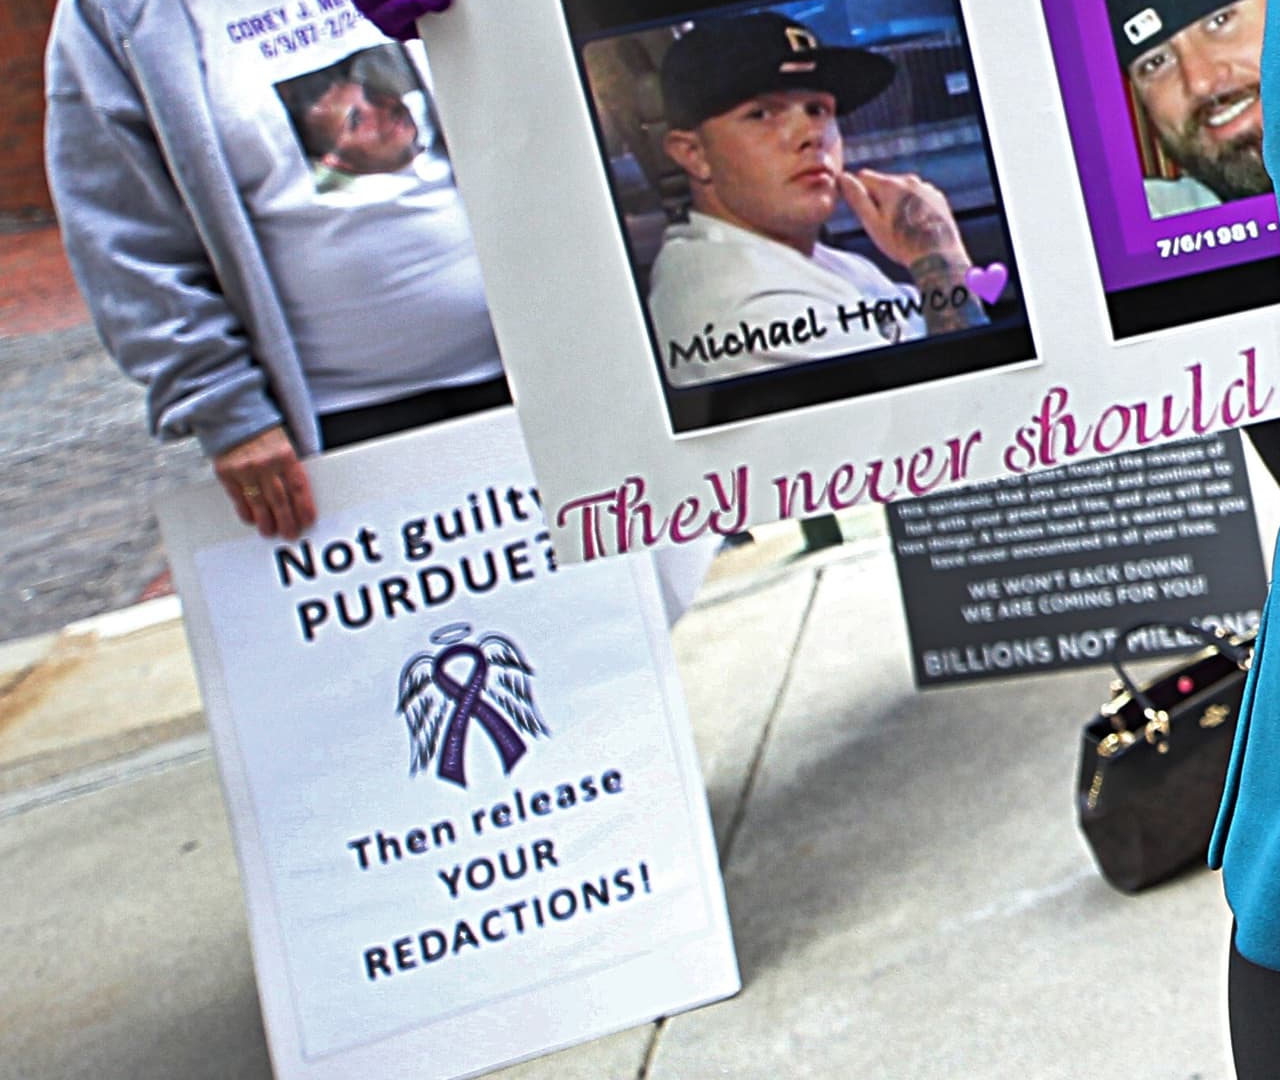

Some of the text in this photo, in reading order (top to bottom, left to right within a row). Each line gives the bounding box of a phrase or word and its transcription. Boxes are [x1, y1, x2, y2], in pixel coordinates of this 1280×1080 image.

[226, 6, 288, 44] COREY
[1156, 219, 1259, 258] 7/6/1981
[668, 285, 969, 370] Michael Hawco
[557, 347, 1276, 561] They never should
[273, 525, 384, 587] Not
[966, 580, 1001, 600] WE
[1069, 563, 1121, 588] BACK
[961, 604, 995, 624] WE
[997, 597, 1036, 620] ARE
[1038, 585, 1115, 615] COMING
[1116, 581, 1159, 604] FOR
[922, 634, 1053, 676] BILLIONS
[1057, 627, 1119, 661] NOT
[348, 768, 624, 871] Then release
[438, 839, 560, 899] YOUR
[364, 862, 652, 981] REDACTIONS!
